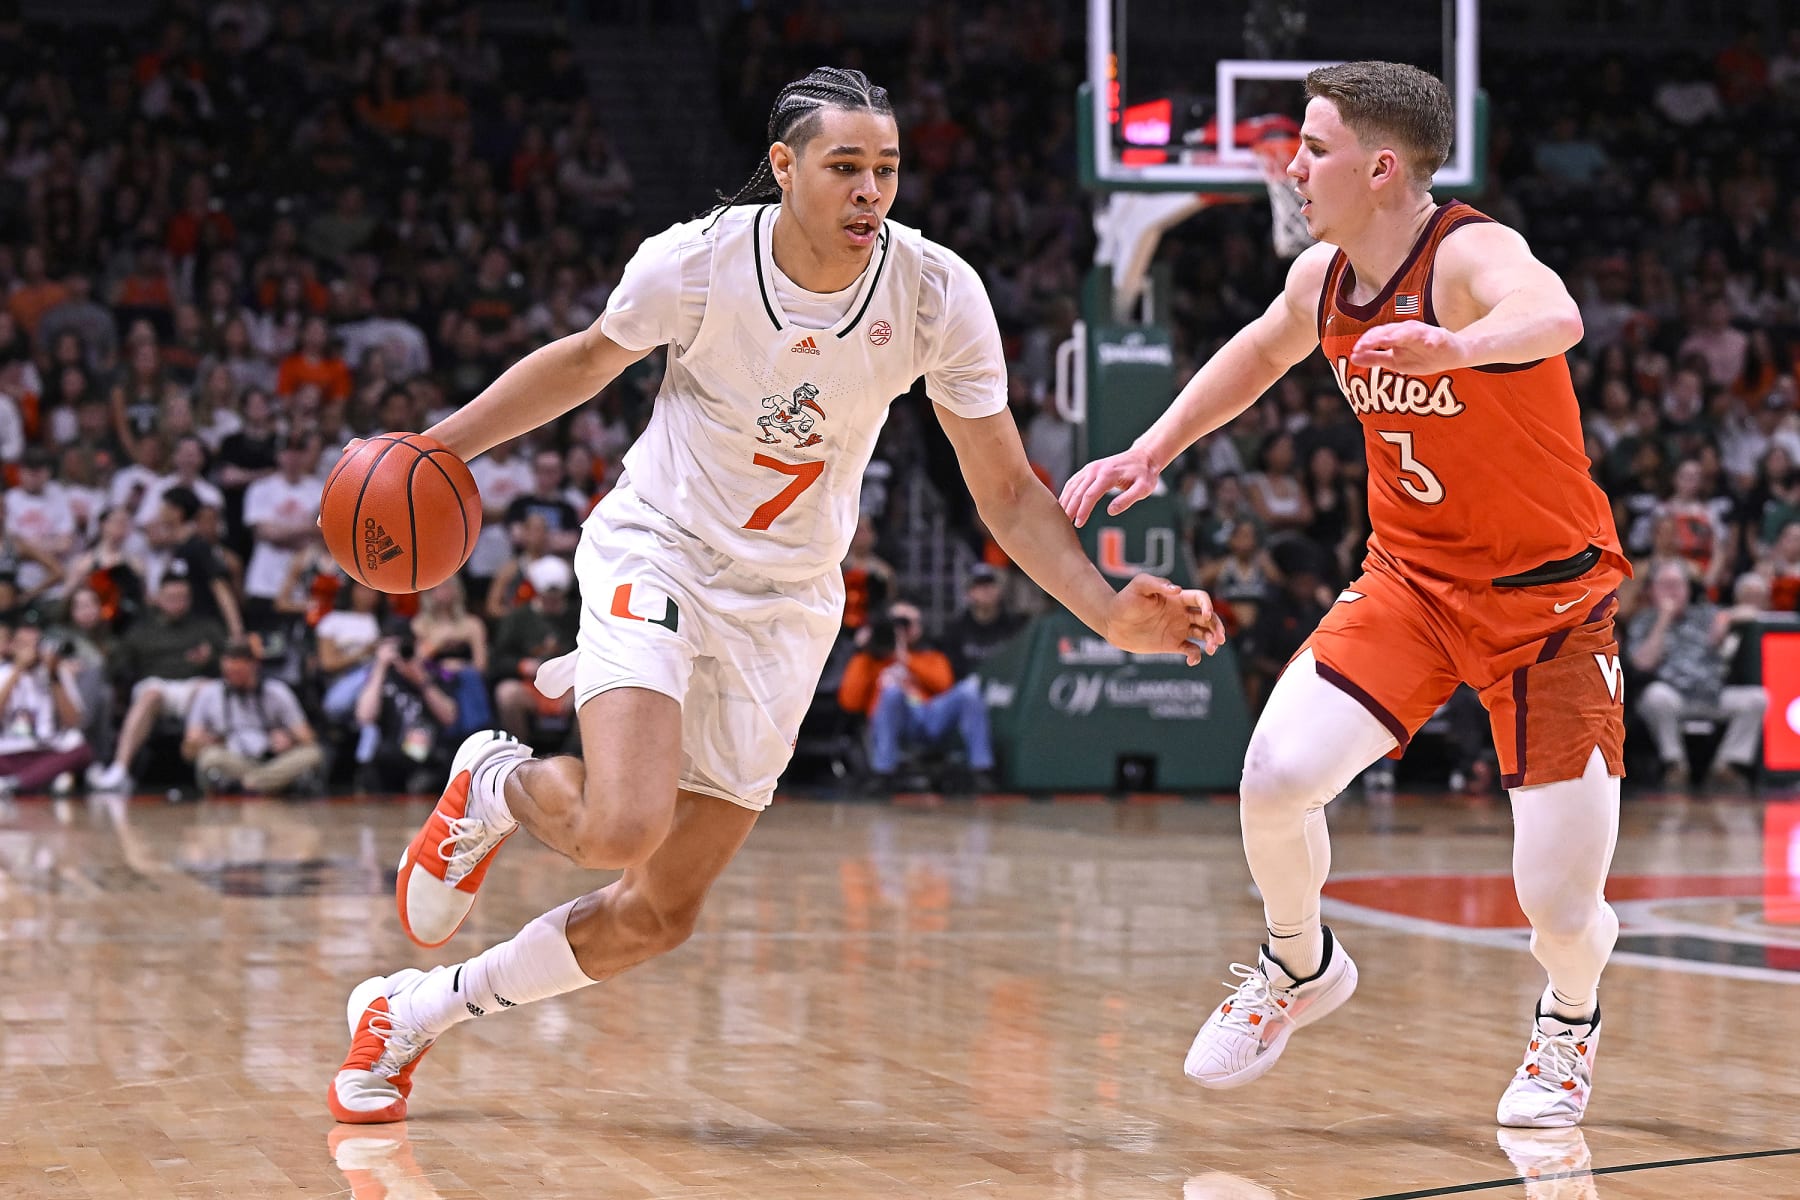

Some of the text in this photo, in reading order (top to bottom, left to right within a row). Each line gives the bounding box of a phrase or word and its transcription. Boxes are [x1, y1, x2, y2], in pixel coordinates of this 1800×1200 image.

[790, 347, 820, 356] adidas
[741, 452, 826, 531] 7
[1376, 430, 1446, 505] 3
[364, 517, 378, 570] adidas
[1097, 526, 1175, 579] U
[610, 583, 679, 633] U
